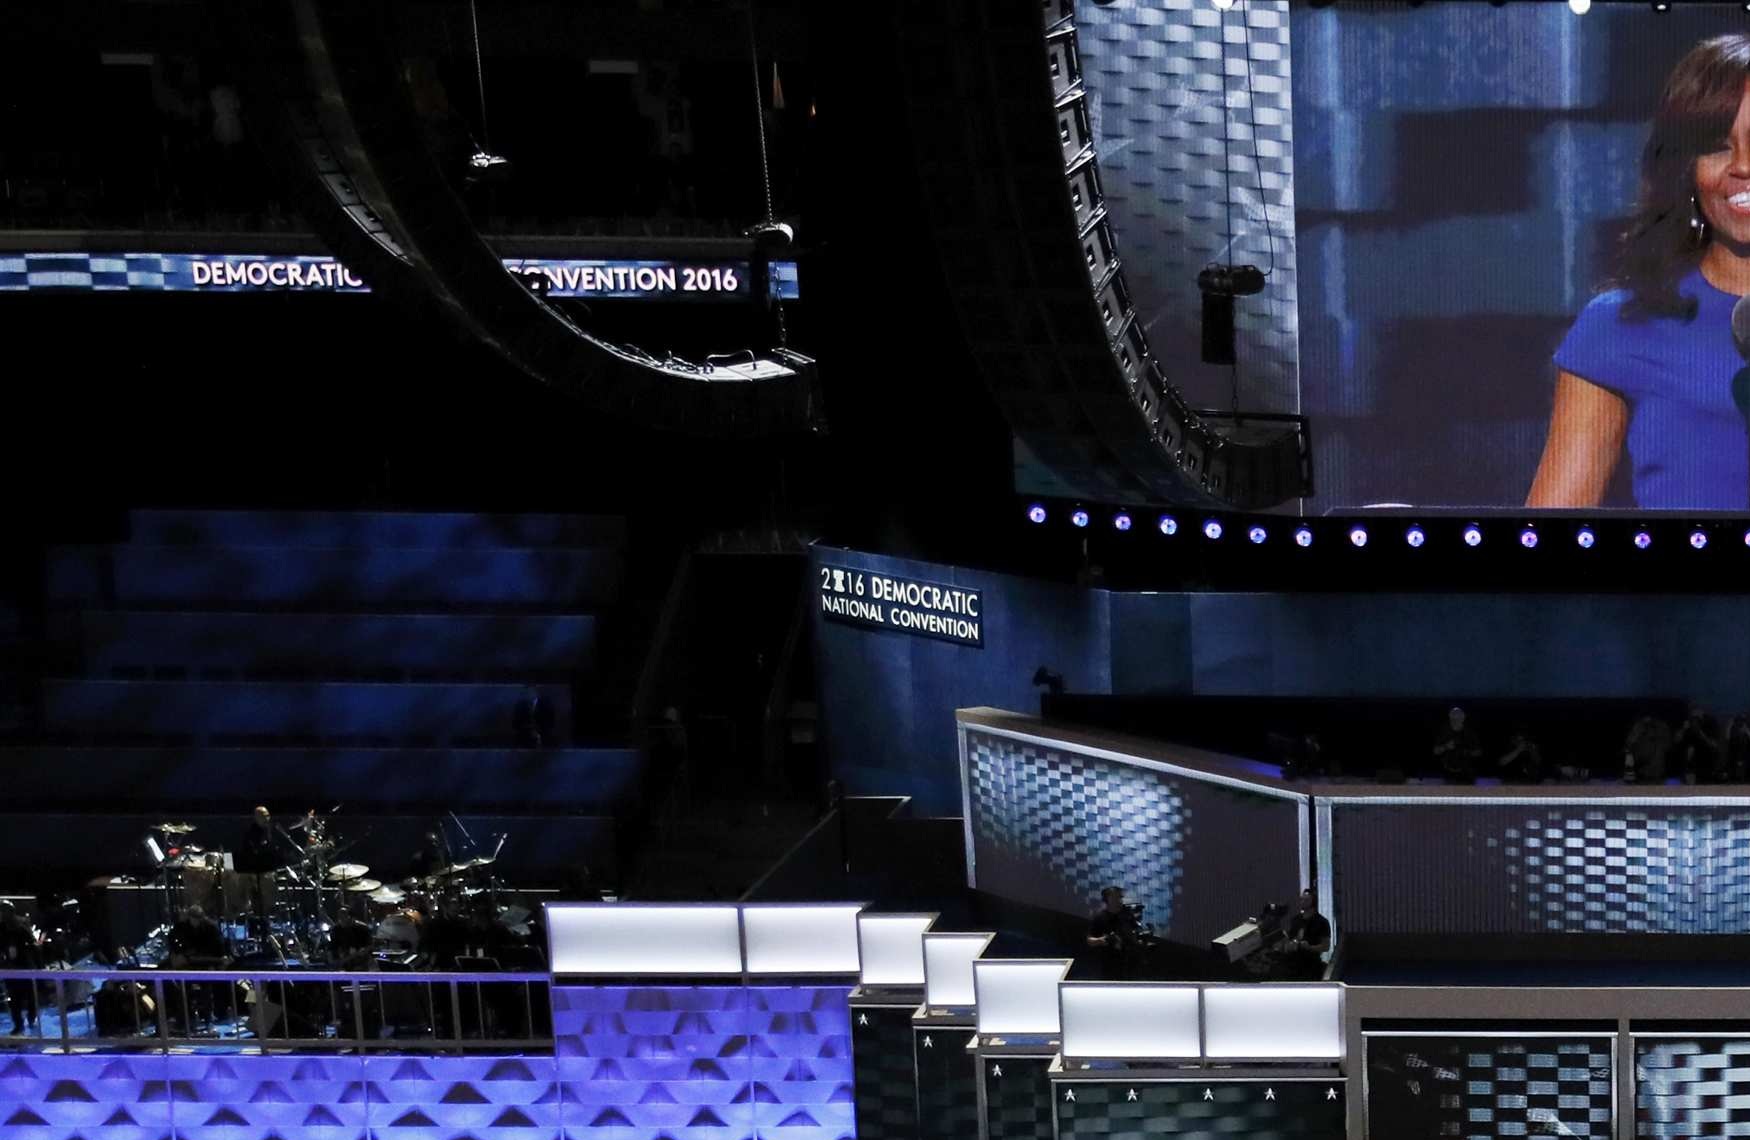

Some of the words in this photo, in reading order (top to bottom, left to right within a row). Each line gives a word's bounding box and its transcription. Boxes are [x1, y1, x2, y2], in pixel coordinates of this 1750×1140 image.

[683, 268, 738, 291] 2016
[872, 576, 978, 617] DEMOCRATIC
[822, 595, 884, 622] NATIONAL
[891, 608, 978, 640] CONVENTION
